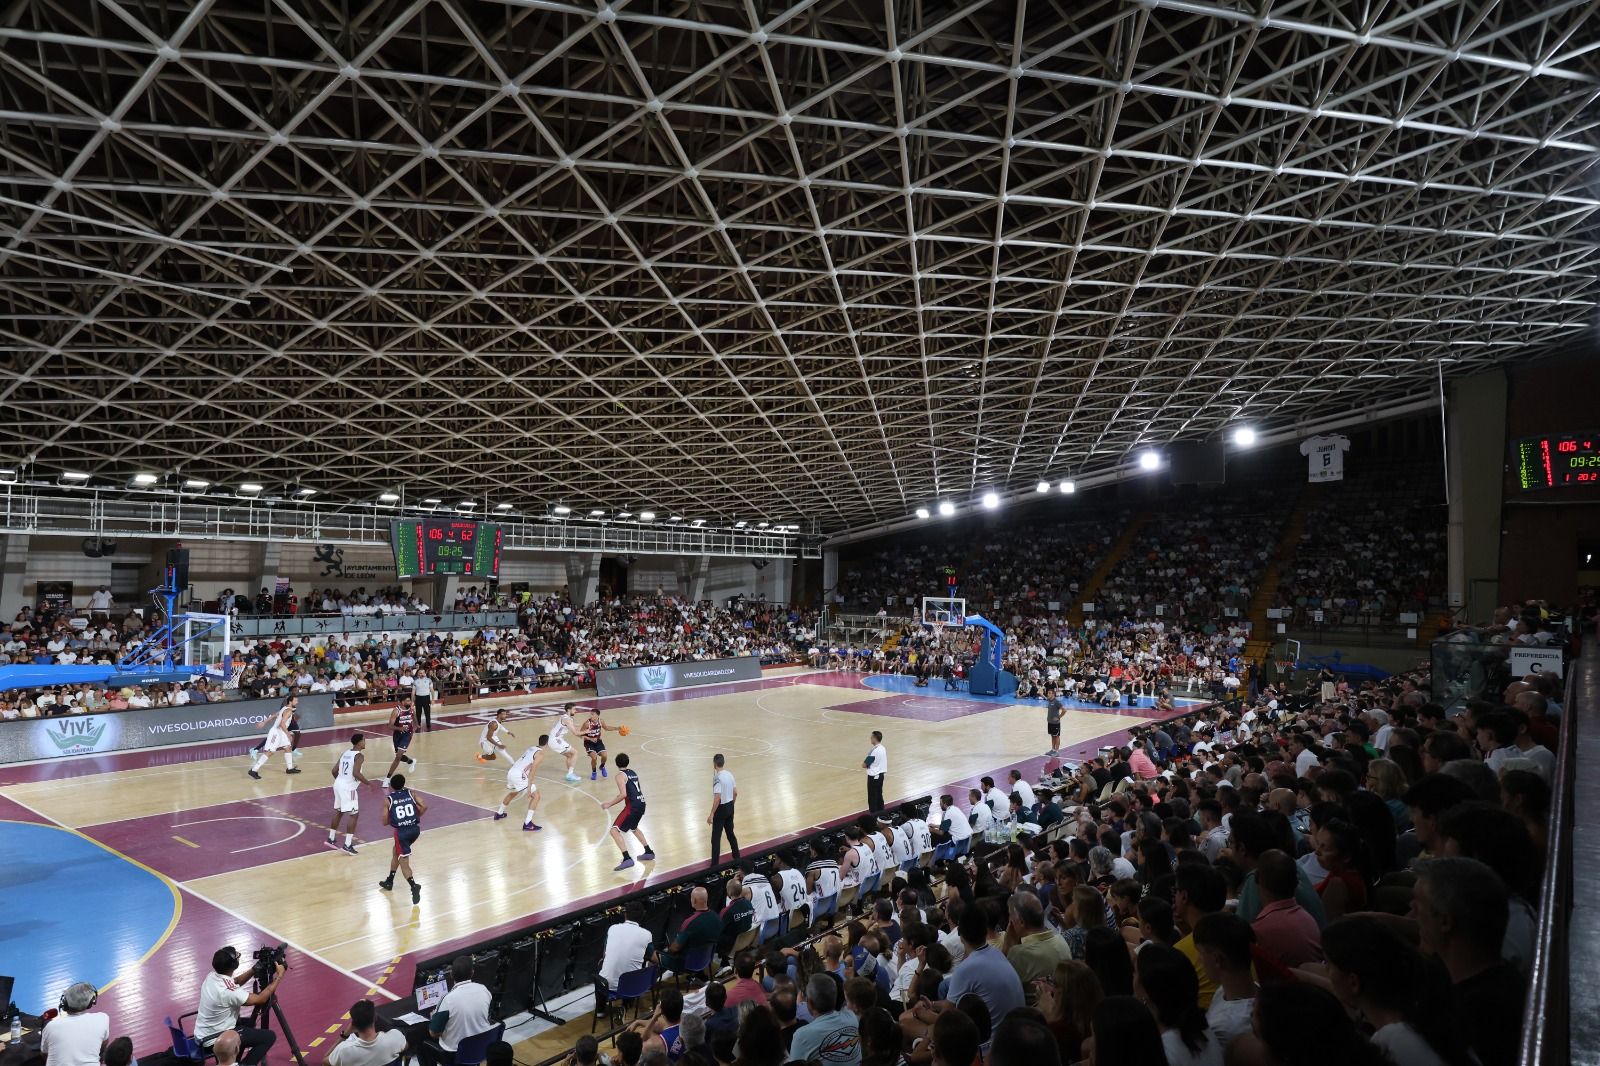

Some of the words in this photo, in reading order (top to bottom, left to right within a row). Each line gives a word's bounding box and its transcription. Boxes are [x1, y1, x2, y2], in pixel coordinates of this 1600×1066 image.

[1559, 441, 1577, 452] 106
[1583, 441, 1591, 449] 4
[428, 529, 443, 540] 106
[448, 530, 454, 538] 4
[461, 529, 473, 541] 62
[438, 545, 463, 557] 09:25
[1514, 652, 1560, 660] PREFERENCIA
[647, 666, 662, 677] VIVE
[1530, 662, 1542, 674] C
[58, 717, 94, 736] VIVE
[148, 714, 272, 734] VIVESOLIDARIDAD.COM
[63, 747, 94, 755] SOLIDARIDAD
[342, 761, 350, 776] 12
[395, 803, 415, 820] 60
[920, 832, 931, 849] 30
[830, 870, 837, 887] 7
[764, 890, 772, 909] 6
[790, 882, 806, 903] 24
